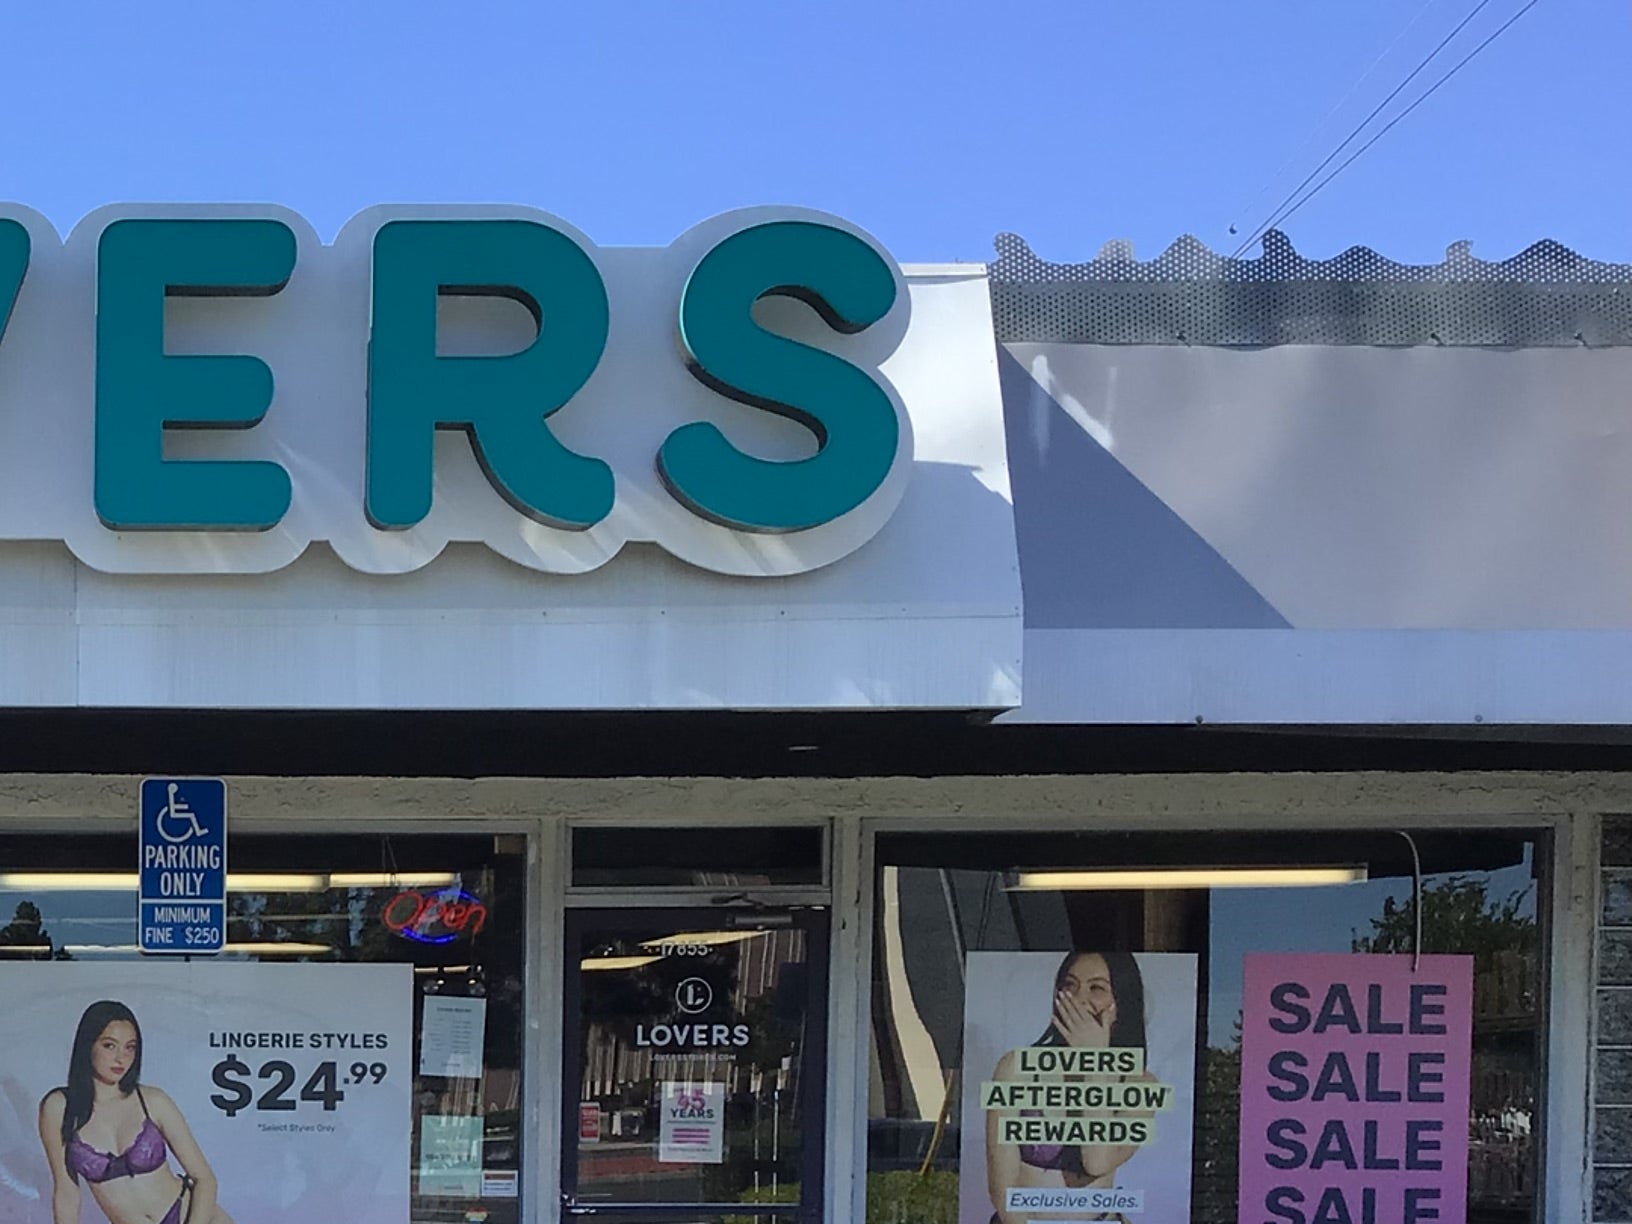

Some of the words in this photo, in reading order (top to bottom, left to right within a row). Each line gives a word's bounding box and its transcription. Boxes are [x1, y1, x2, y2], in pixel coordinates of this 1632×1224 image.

[145, 845, 220, 869] PARKING
[160, 872, 205, 896] ONLY
[154, 907, 211, 923] MINIMUM
[384, 889, 487, 936] Open
[145, 927, 173, 944] FINE
[185, 926, 220, 944] $250
[1268, 982, 1447, 1035] SALE
[209, 1032, 304, 1048] LINGERIE
[309, 1033, 388, 1049] STYLES
[636, 1024, 749, 1046] LOVERS
[1021, 1051, 1135, 1072] LOVERS
[1266, 1050, 1445, 1103] SALE
[986, 1086, 1166, 1107] AFTERGLOW
[671, 1108, 714, 1118] YEARS
[289, 1124, 315, 1133] Styles
[317, 1124, 335, 1133] Only
[1005, 1121, 1147, 1142] REWARDS
[1264, 1118, 1443, 1171] SALE
[1010, 1193, 1087, 1208] Exclusive
[1091, 1193, 1138, 1208] Sales.
